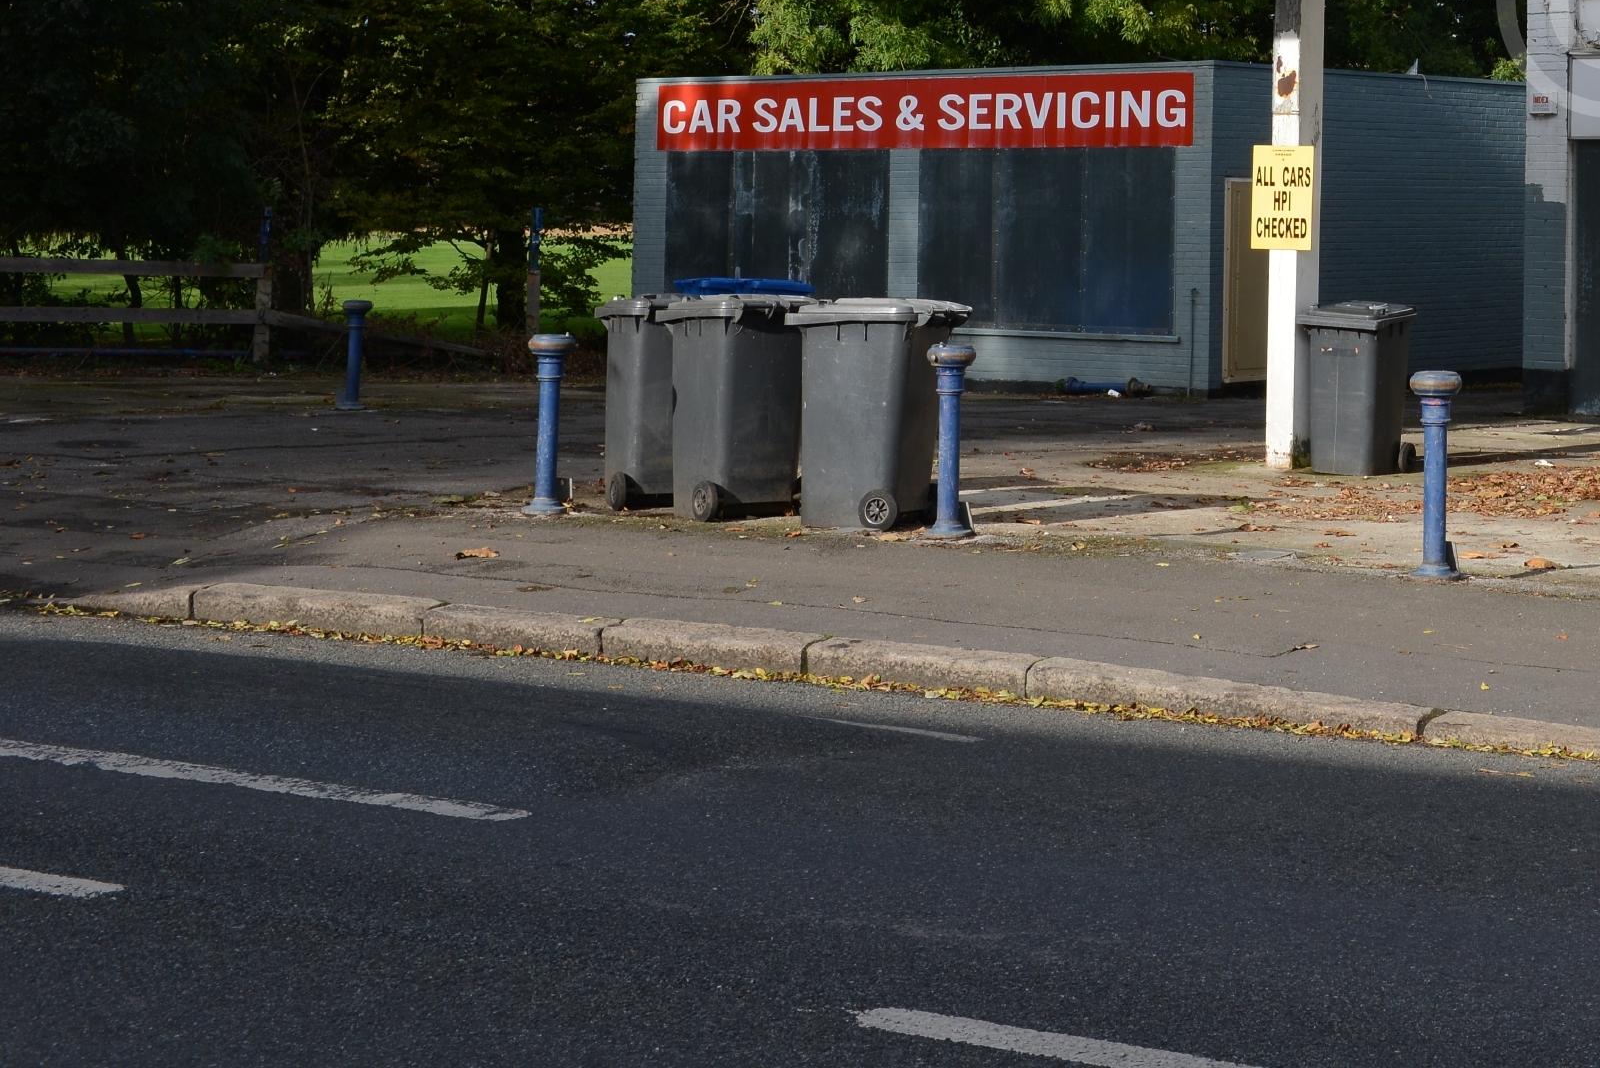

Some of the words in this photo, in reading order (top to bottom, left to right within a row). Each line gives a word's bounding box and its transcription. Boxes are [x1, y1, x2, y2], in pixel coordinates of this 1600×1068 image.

[663, 99, 741, 134] CAR
[752, 95, 883, 133] SALES
[895, 95, 925, 131] &
[937, 89, 1186, 131] SERVICING
[1256, 166, 1275, 186] ALL
[1282, 166, 1311, 187] CARS
[1273, 191, 1291, 211] HPI
[1256, 217, 1307, 238] CHECKED
